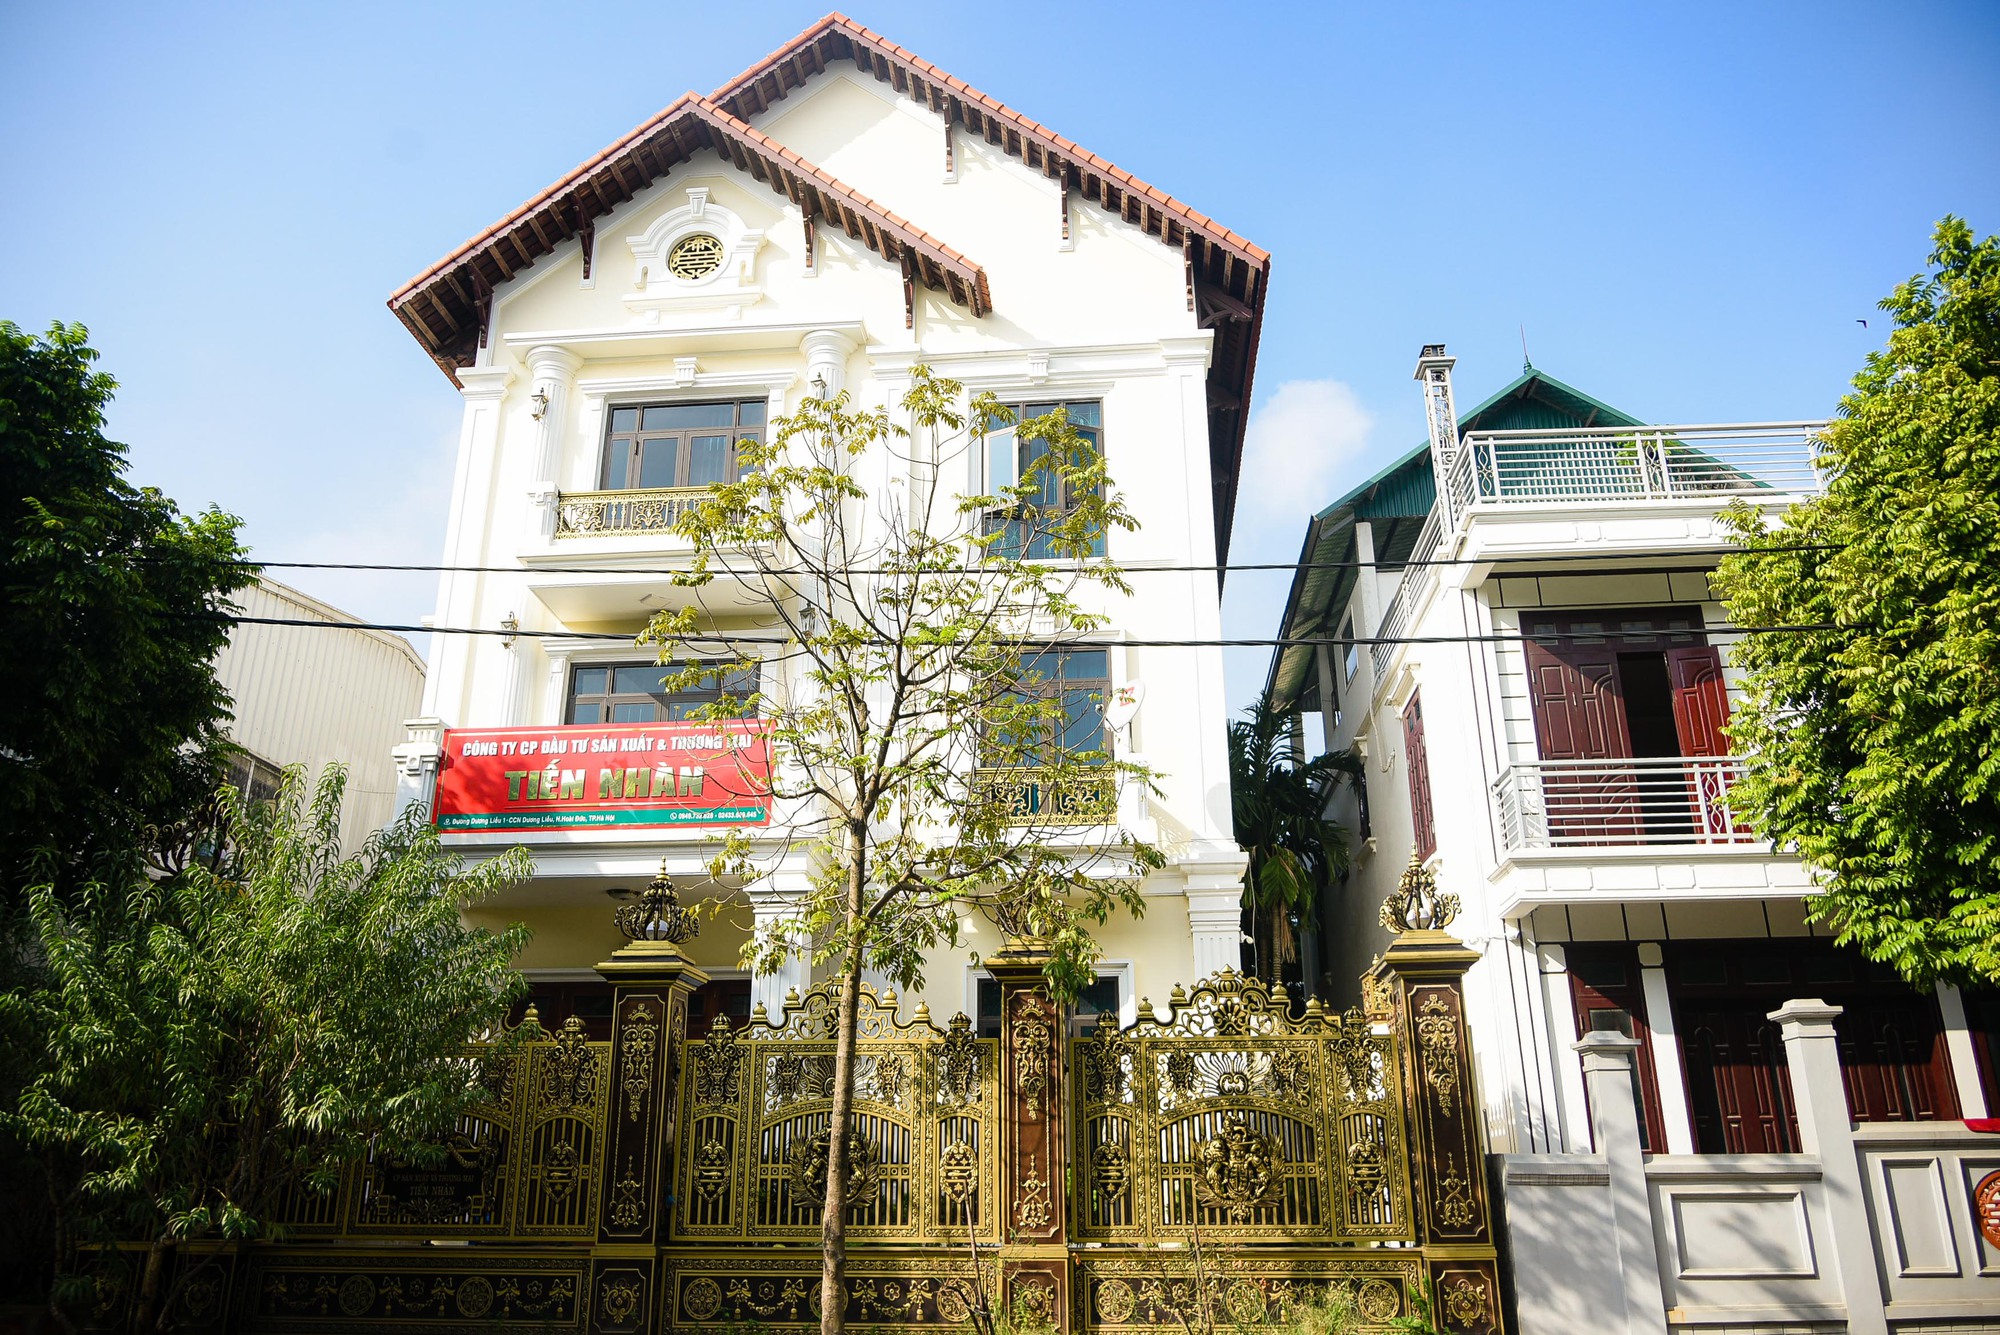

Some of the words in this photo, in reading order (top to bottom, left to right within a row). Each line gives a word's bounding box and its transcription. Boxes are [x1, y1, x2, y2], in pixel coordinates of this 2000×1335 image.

[462, 740, 498, 756] CÔNG
[501, 741, 518, 755] TY
[519, 740, 539, 755] CP
[541, 736, 568, 754] ĐẦU
[571, 737, 590, 753] TƯ
[591, 735, 618, 753] SẢN
[620, 733, 654, 752] XUẤT
[656, 739, 667, 750] &
[671, 734, 723, 750] THƯƠNG
[726, 734, 752, 752] MẠI
[504, 758, 586, 800] TIẾN
[599, 762, 704, 799] NHÀN
